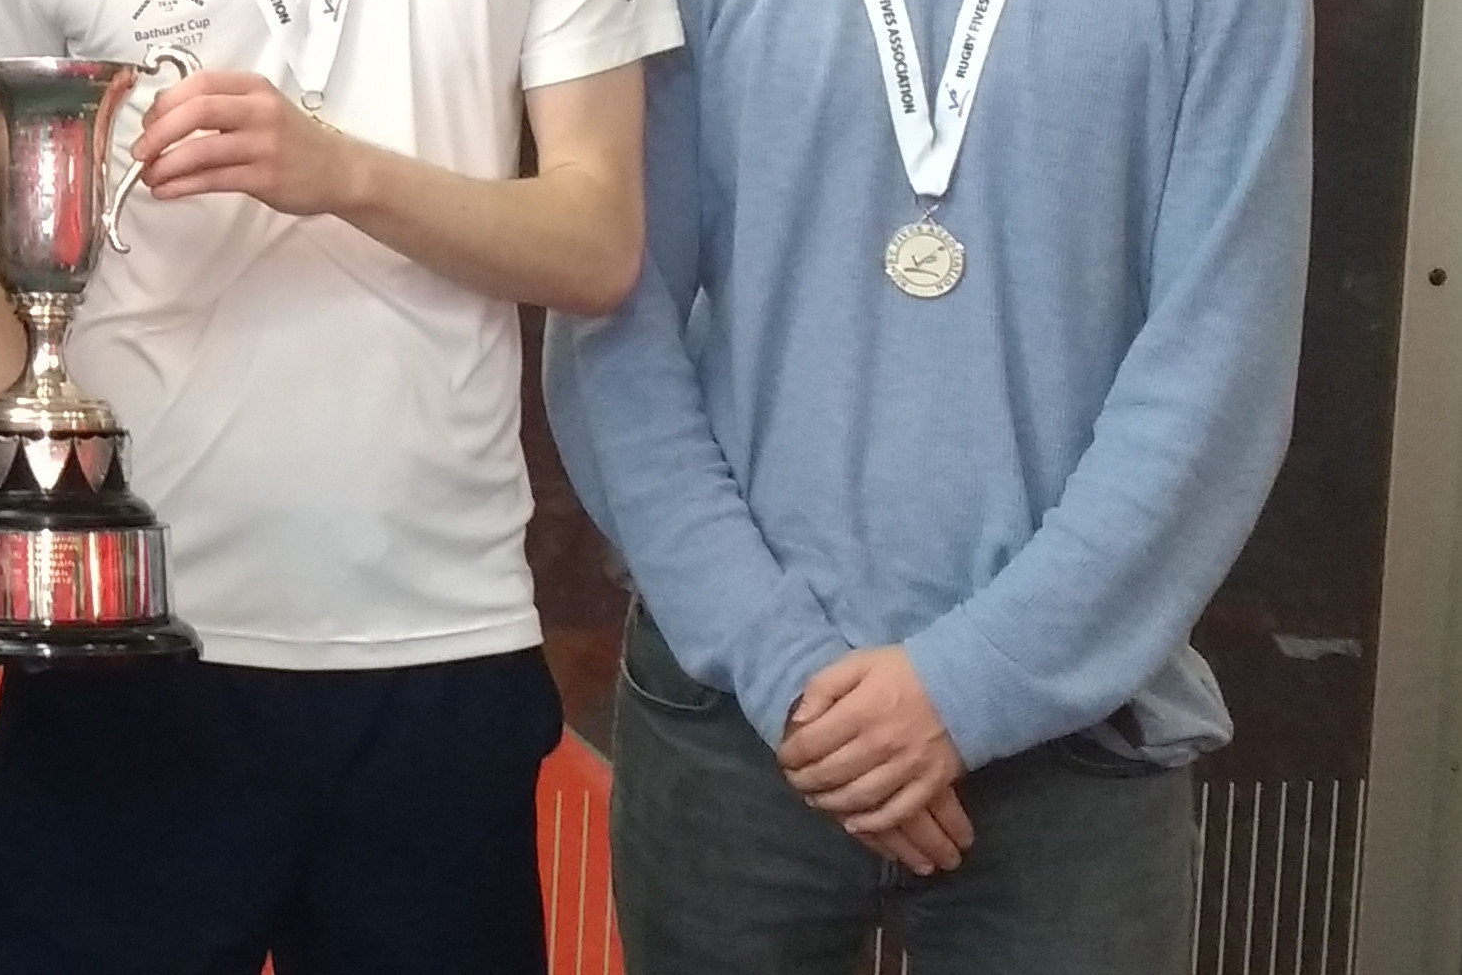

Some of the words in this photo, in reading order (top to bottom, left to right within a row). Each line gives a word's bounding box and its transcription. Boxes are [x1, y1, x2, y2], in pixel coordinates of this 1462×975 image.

[134, 23, 185, 41] Bathurst
[187, 18, 210, 34] Cup
[887, 28, 917, 114] ASSOCIATION
[955, 33, 977, 79] RUGBY
